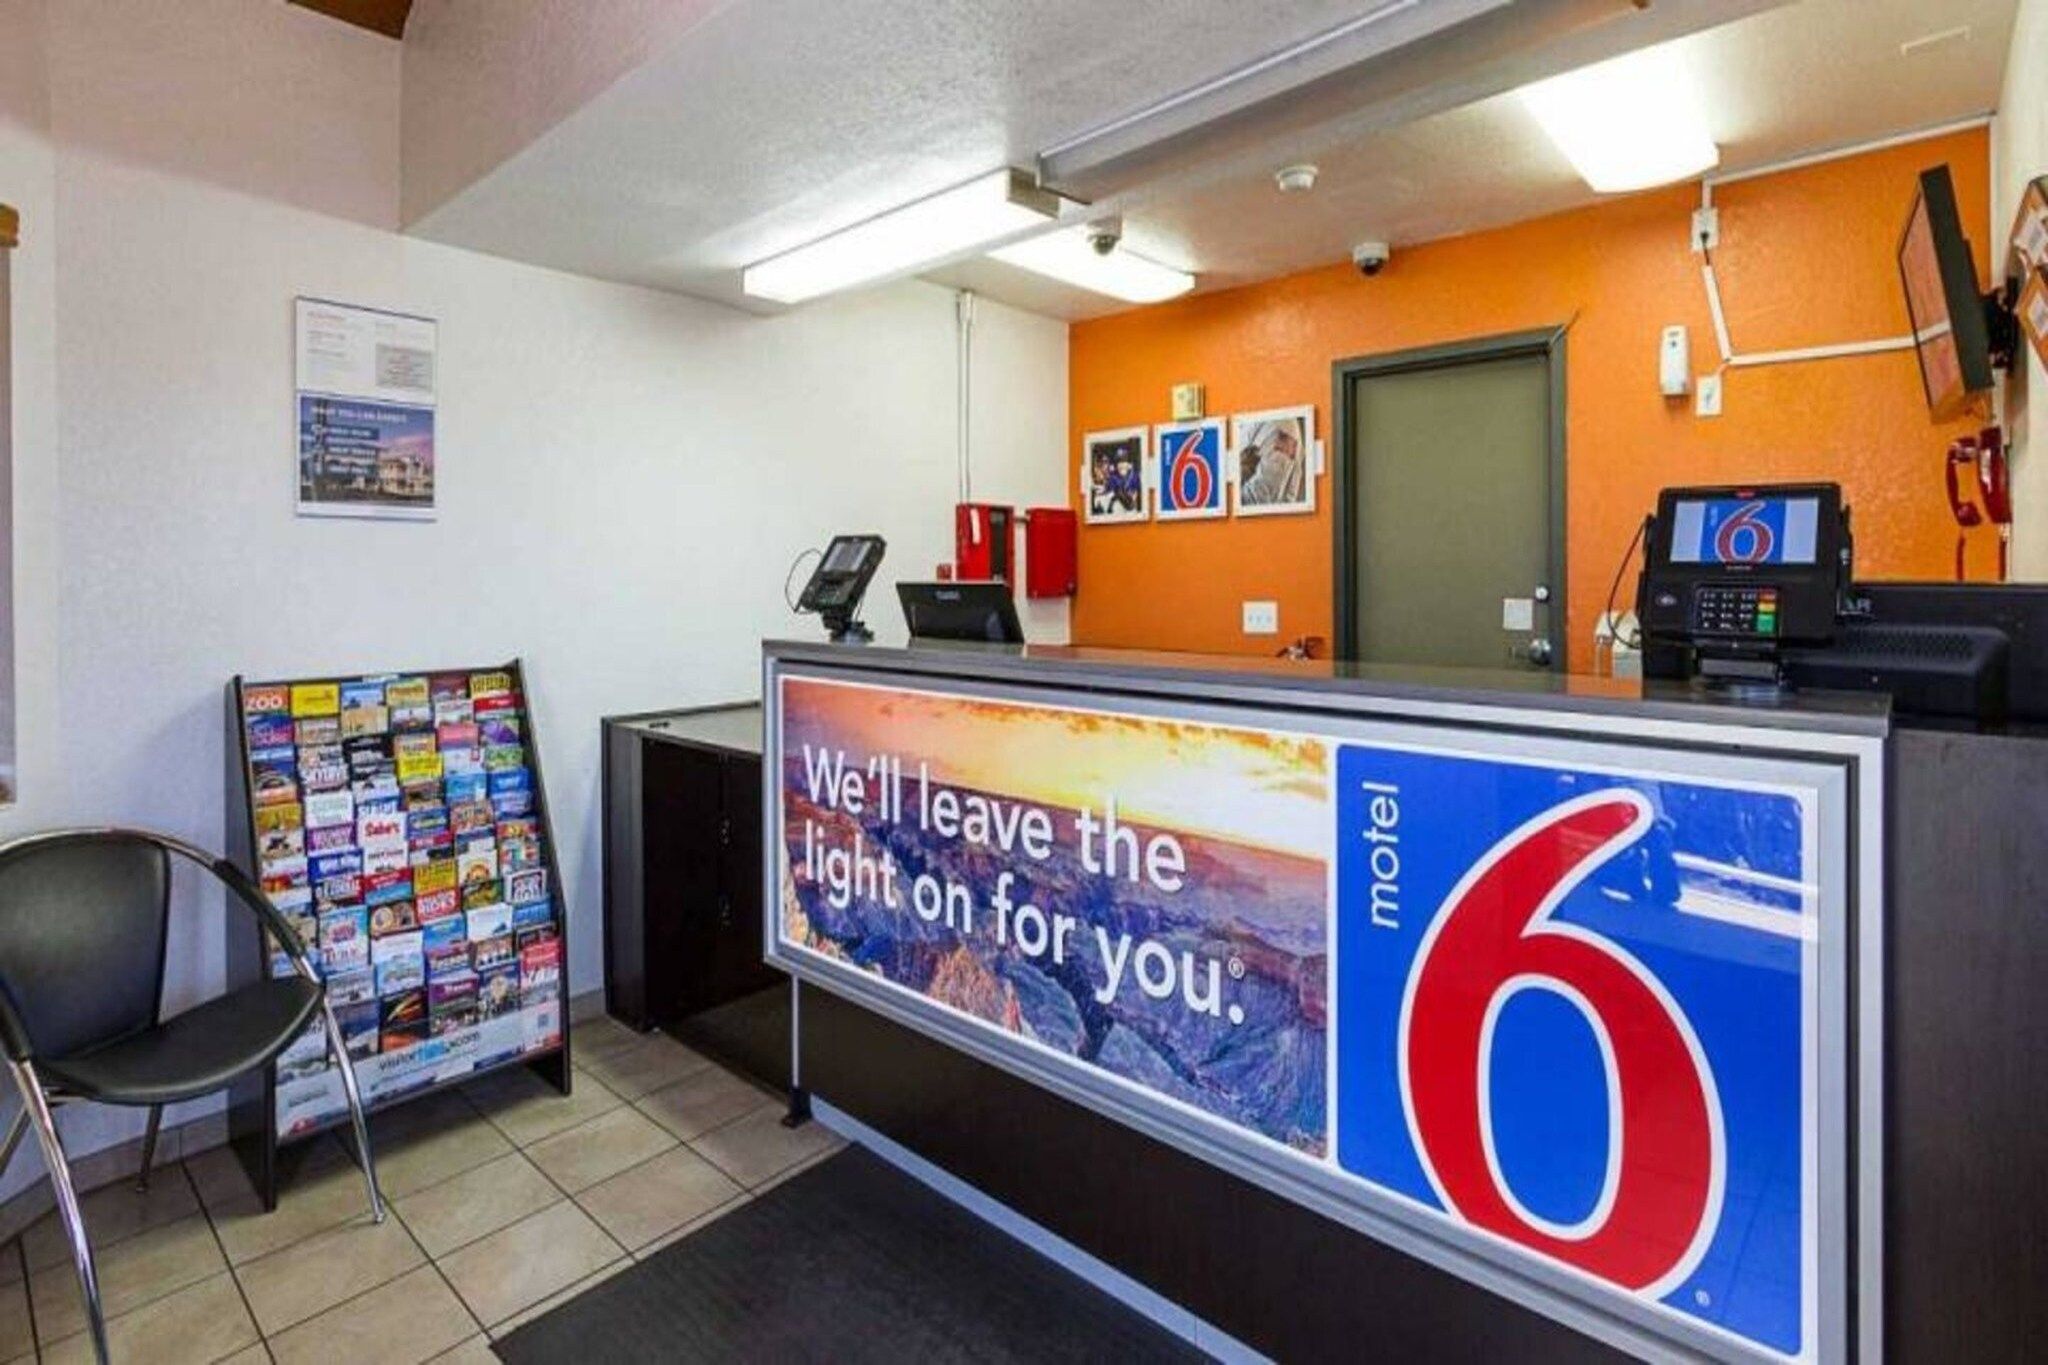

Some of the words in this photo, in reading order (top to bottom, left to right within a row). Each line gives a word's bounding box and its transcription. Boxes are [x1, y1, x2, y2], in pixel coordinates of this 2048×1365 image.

[1170, 431, 1212, 509] 6
[1715, 500, 1774, 562] 6
[803, 744, 901, 825] We'll
[919, 762, 1053, 860] leave
[1075, 795, 1186, 893] the
[804, 818, 897, 909] light
[912, 872, 972, 934] on
[991, 872, 1076, 965] for
[1362, 781, 1401, 930] motel
[1397, 787, 1728, 1302] 6
